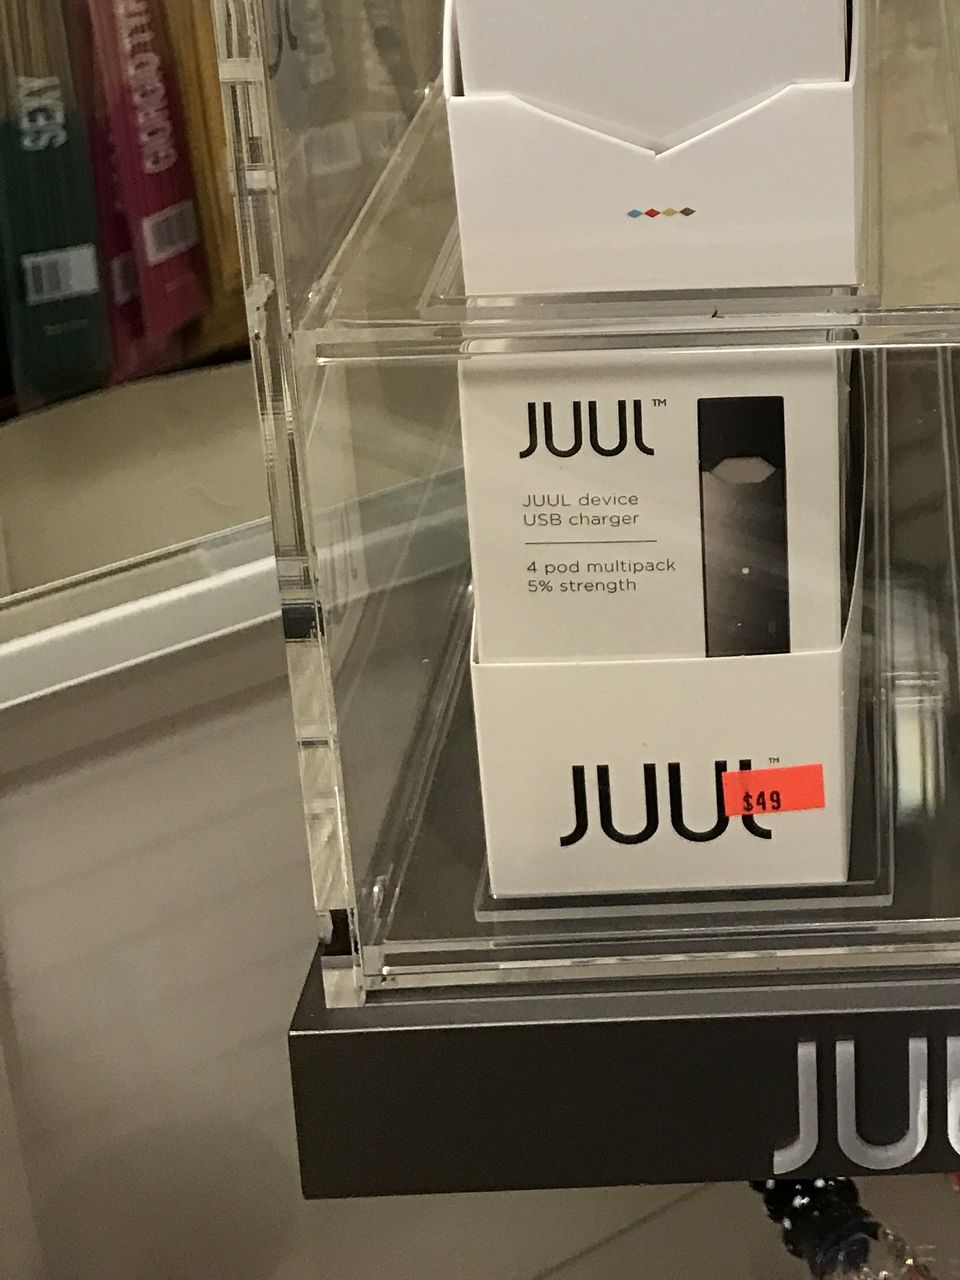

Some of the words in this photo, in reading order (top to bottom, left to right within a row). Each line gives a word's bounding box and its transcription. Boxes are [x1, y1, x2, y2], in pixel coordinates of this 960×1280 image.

[518, 398, 655, 459] JUUL
[522, 494, 571, 508] JUUL
[578, 493, 639, 507] device
[523, 512, 563, 527] USB
[568, 512, 639, 528] charger
[526, 561, 538, 574] 4
[544, 560, 580, 576] pod
[586, 558, 677, 575] multipack
[527, 579, 554, 593] 5%
[559, 578, 637, 594] strength
[742, 790, 782, 812] $49
